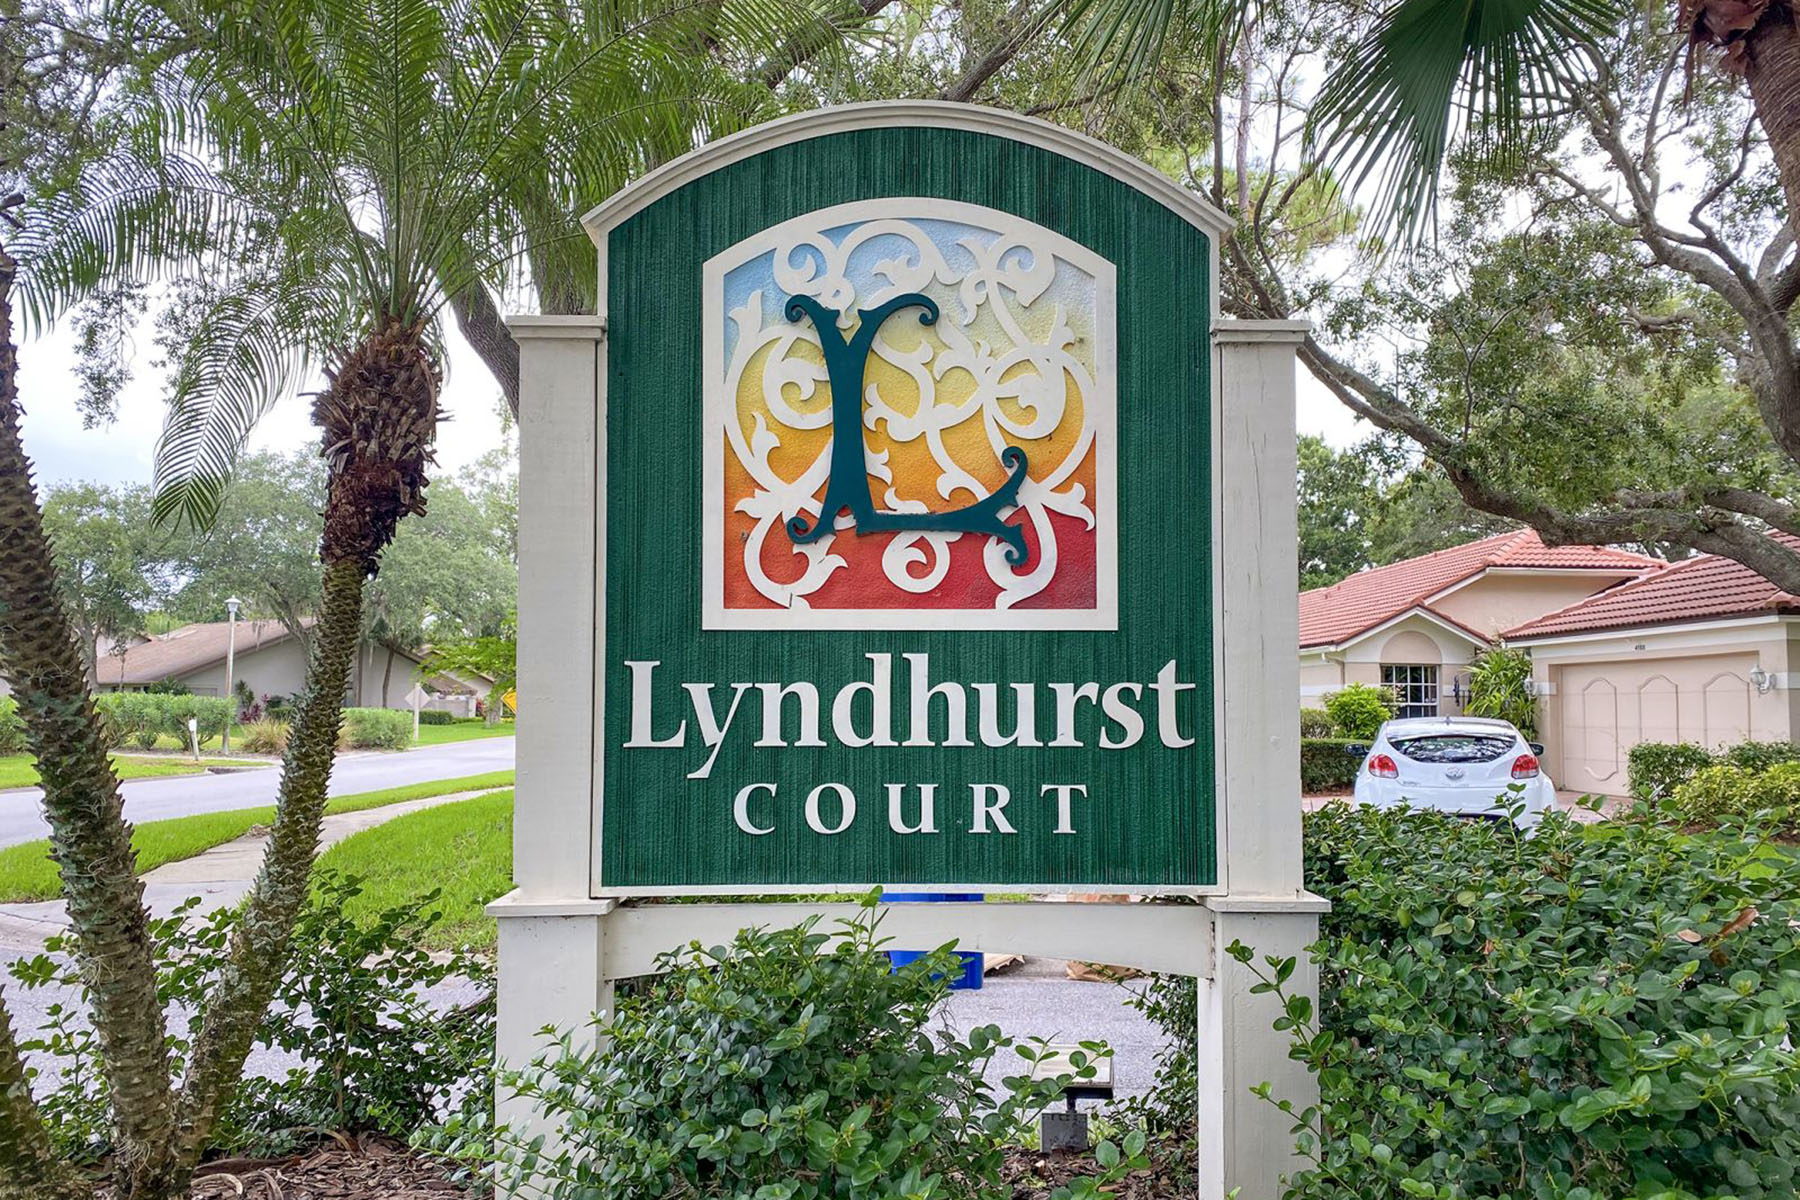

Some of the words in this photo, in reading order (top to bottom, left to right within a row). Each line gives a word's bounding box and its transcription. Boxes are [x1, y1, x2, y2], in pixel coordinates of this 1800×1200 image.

[785, 293, 1028, 568] L
[623, 652, 1196, 779] Lyndhurst
[733, 783, 1088, 835] COURT
